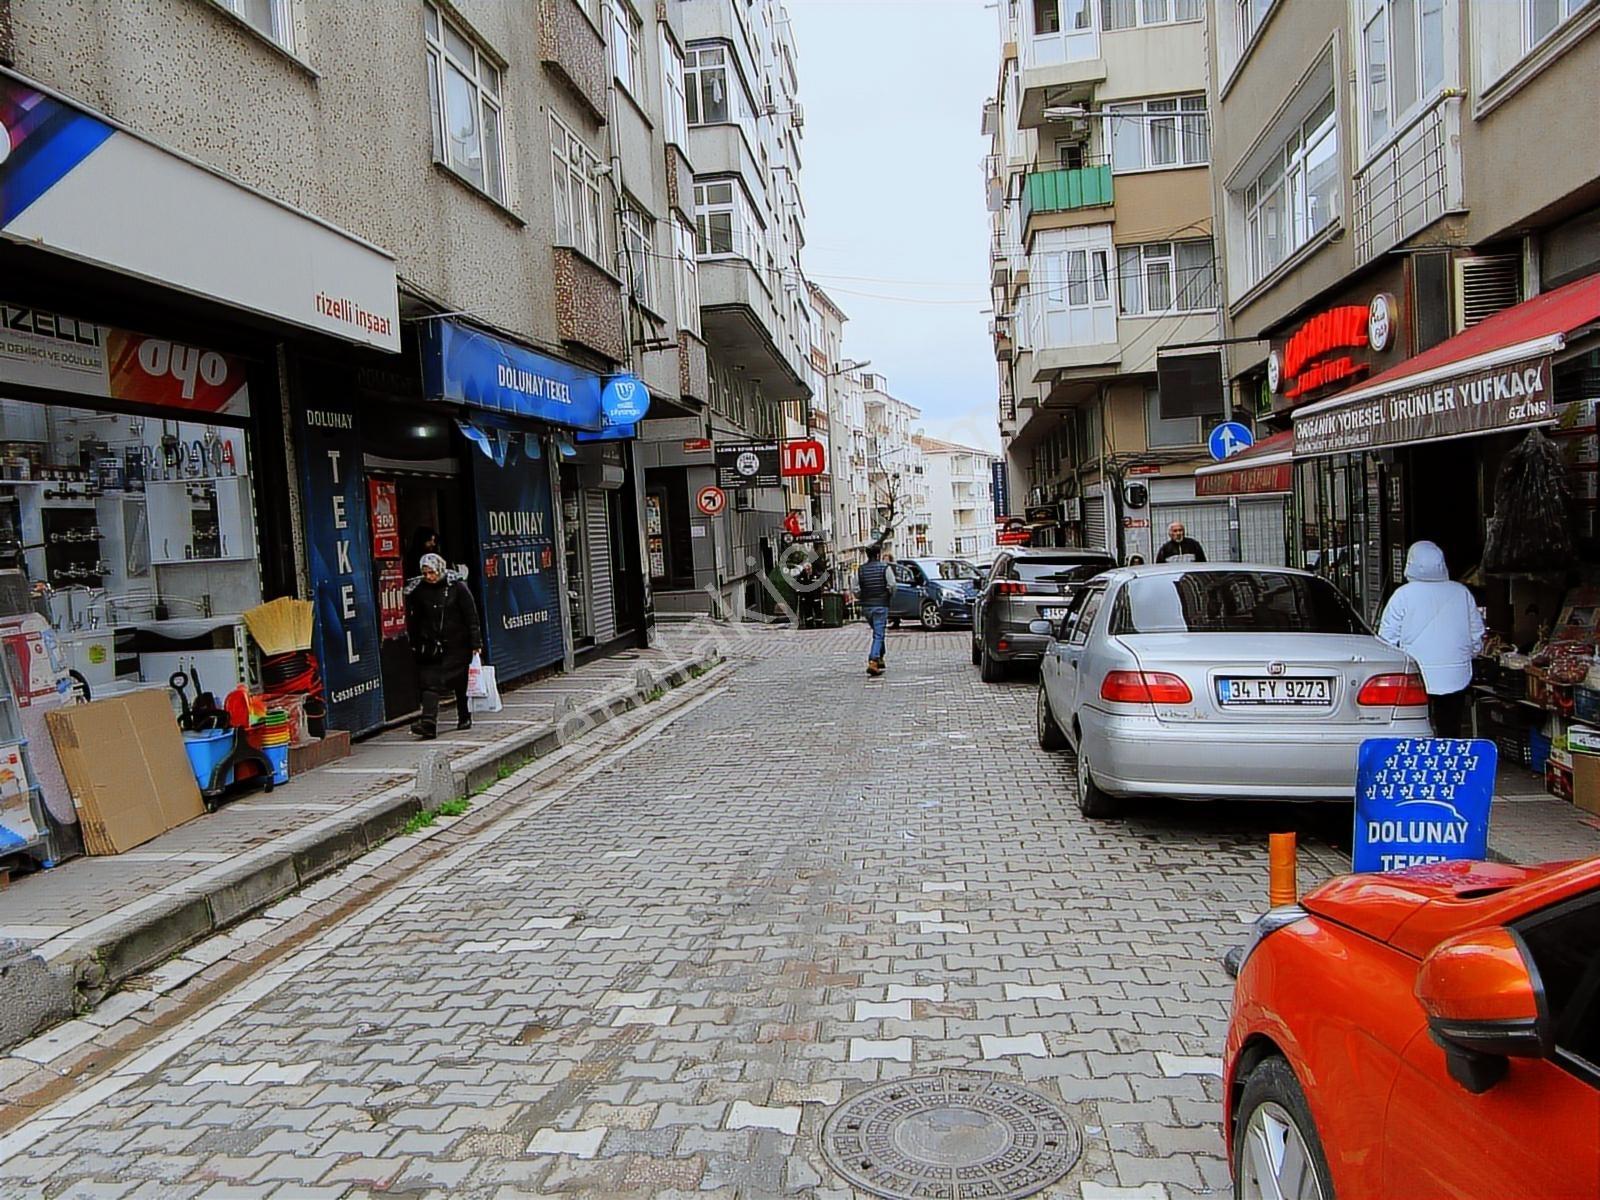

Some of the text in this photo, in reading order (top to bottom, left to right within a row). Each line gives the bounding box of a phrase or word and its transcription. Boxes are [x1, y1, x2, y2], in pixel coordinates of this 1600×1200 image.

[316, 291, 391, 337] rizelli inşaat
[498, 364, 572, 404] DOLUNAY TEKEL
[1389, 387, 1456, 422] ÜRÜNLER
[306, 409, 353, 429] DOLUNAY
[783, 444, 818, 470] İM
[489, 511, 544, 536] DOLUNAY
[327, 450, 361, 665] TEKEL
[502, 551, 540, 578] TEKEL
[1231, 679, 1327, 699] 34 FY 9273
[1368, 821, 1469, 844] DOLUNAY
[1380, 855, 1447, 872] TEK
